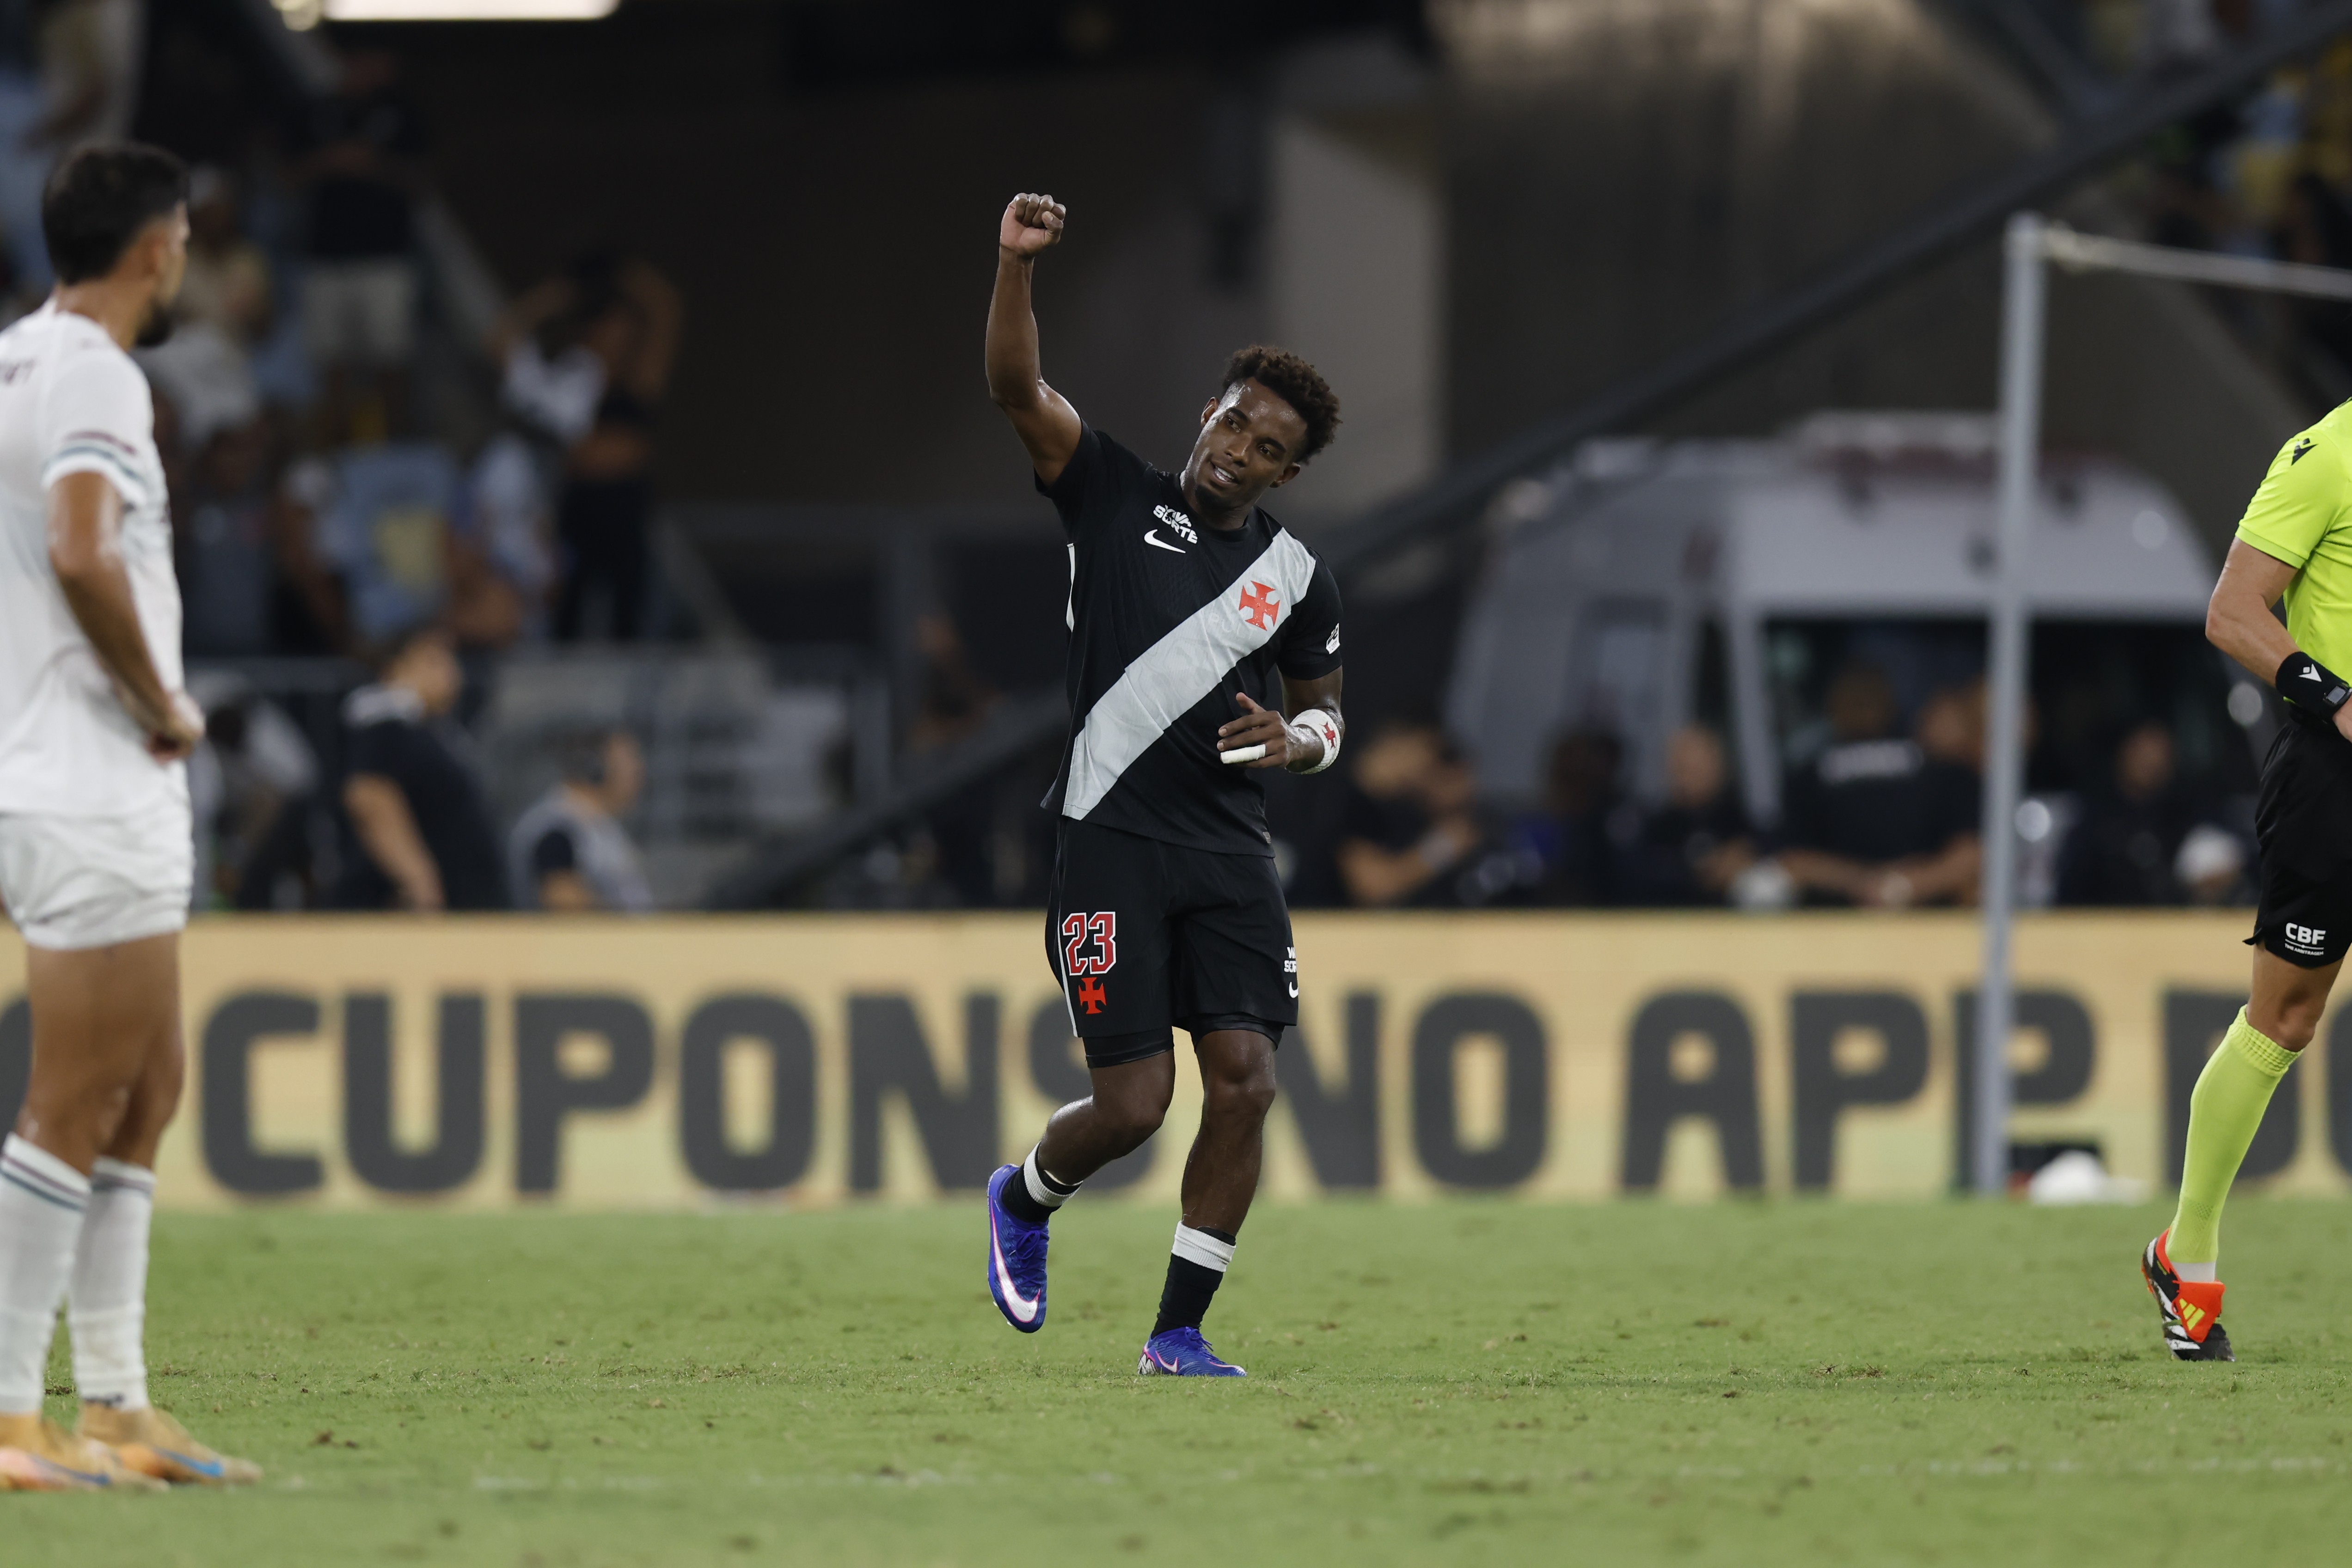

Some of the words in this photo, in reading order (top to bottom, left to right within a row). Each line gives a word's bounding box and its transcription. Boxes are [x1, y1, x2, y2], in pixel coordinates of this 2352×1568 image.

[1062, 911, 1116, 976] 23
[2285, 922, 2326, 945] CBF
[1619, 987, 2096, 1189] APP
